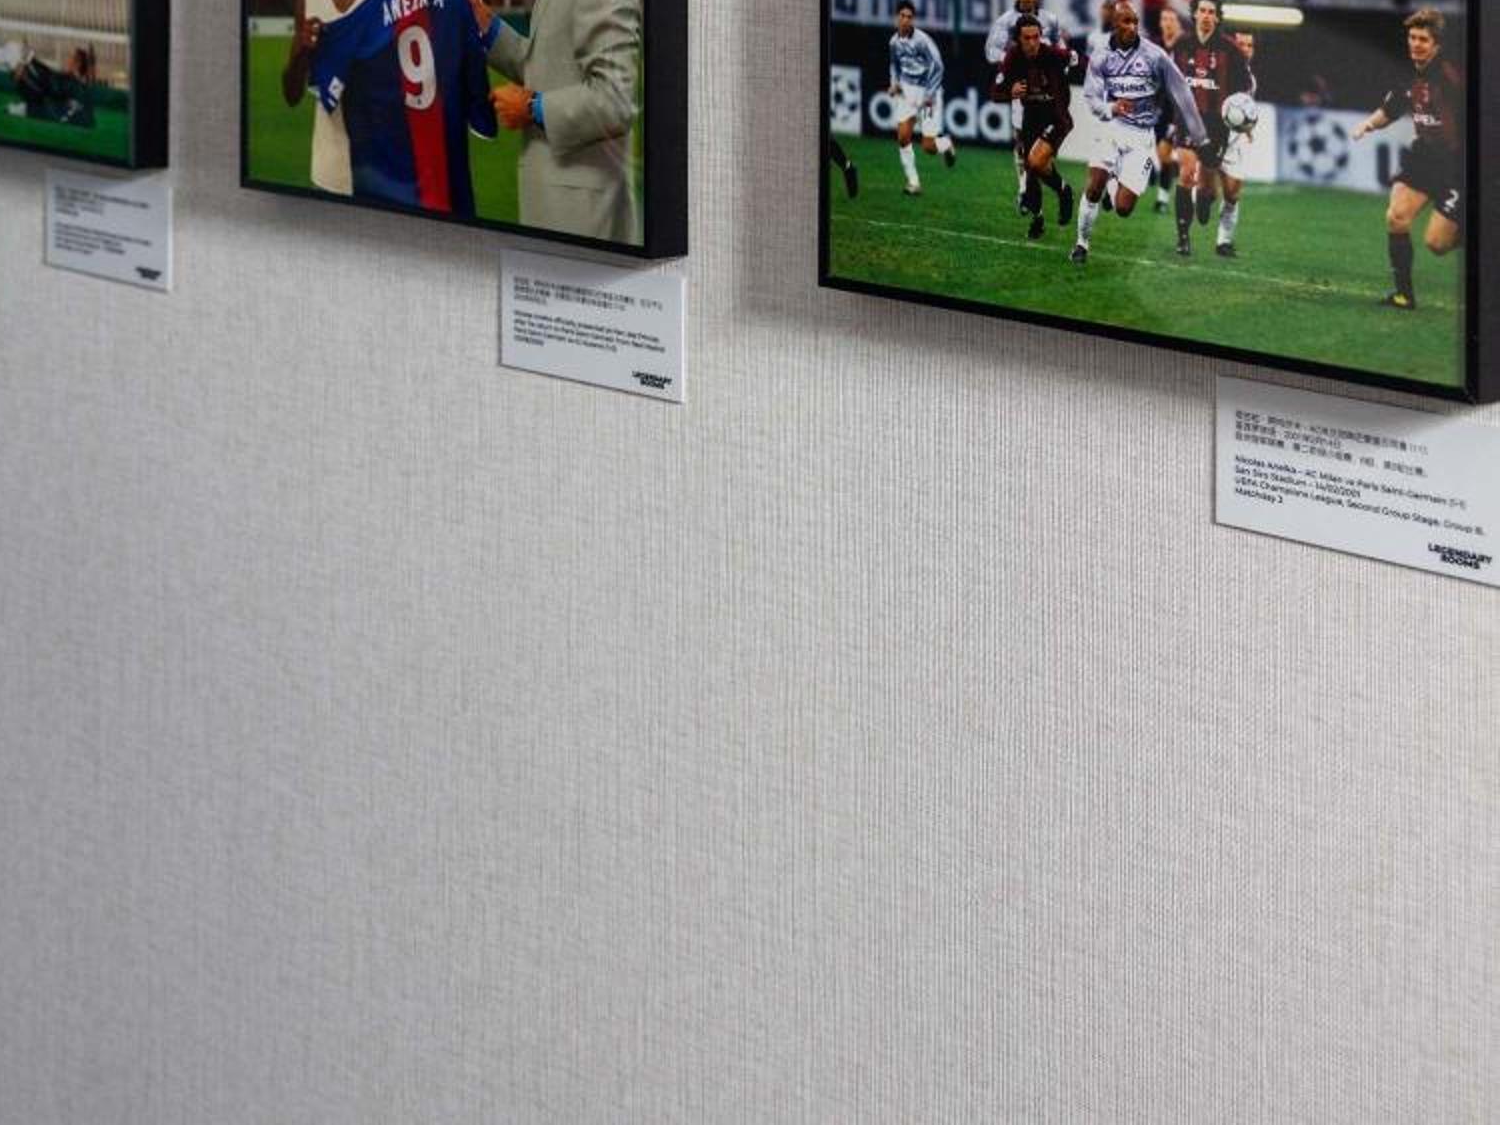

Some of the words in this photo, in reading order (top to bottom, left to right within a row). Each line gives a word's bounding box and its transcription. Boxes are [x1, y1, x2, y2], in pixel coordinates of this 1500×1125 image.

[397, 24, 437, 111] 9
[1235, 464, 1251, 475] San
[1252, 468, 1269, 481] Siro
[1270, 473, 1307, 487] Stadium
[1235, 455, 1265, 468] Nicolas
[1267, 461, 1297, 474] Anelka
[1320, 472, 1342, 484] Milan
[1357, 478, 1379, 491] Paris
[1381, 484, 1447, 504] Saint-Germain
[1235, 487, 1276, 504] Matchday
[1235, 475, 1258, 487] UEFA
[1260, 480, 1308, 498] Champions
[1347, 498, 1380, 514] Second
[1381, 506, 1410, 521] Group
[1443, 519, 1472, 534] Group
[1428, 543, 1492, 564] LEGENDARY
[1440, 553, 1480, 570] ROOMS
